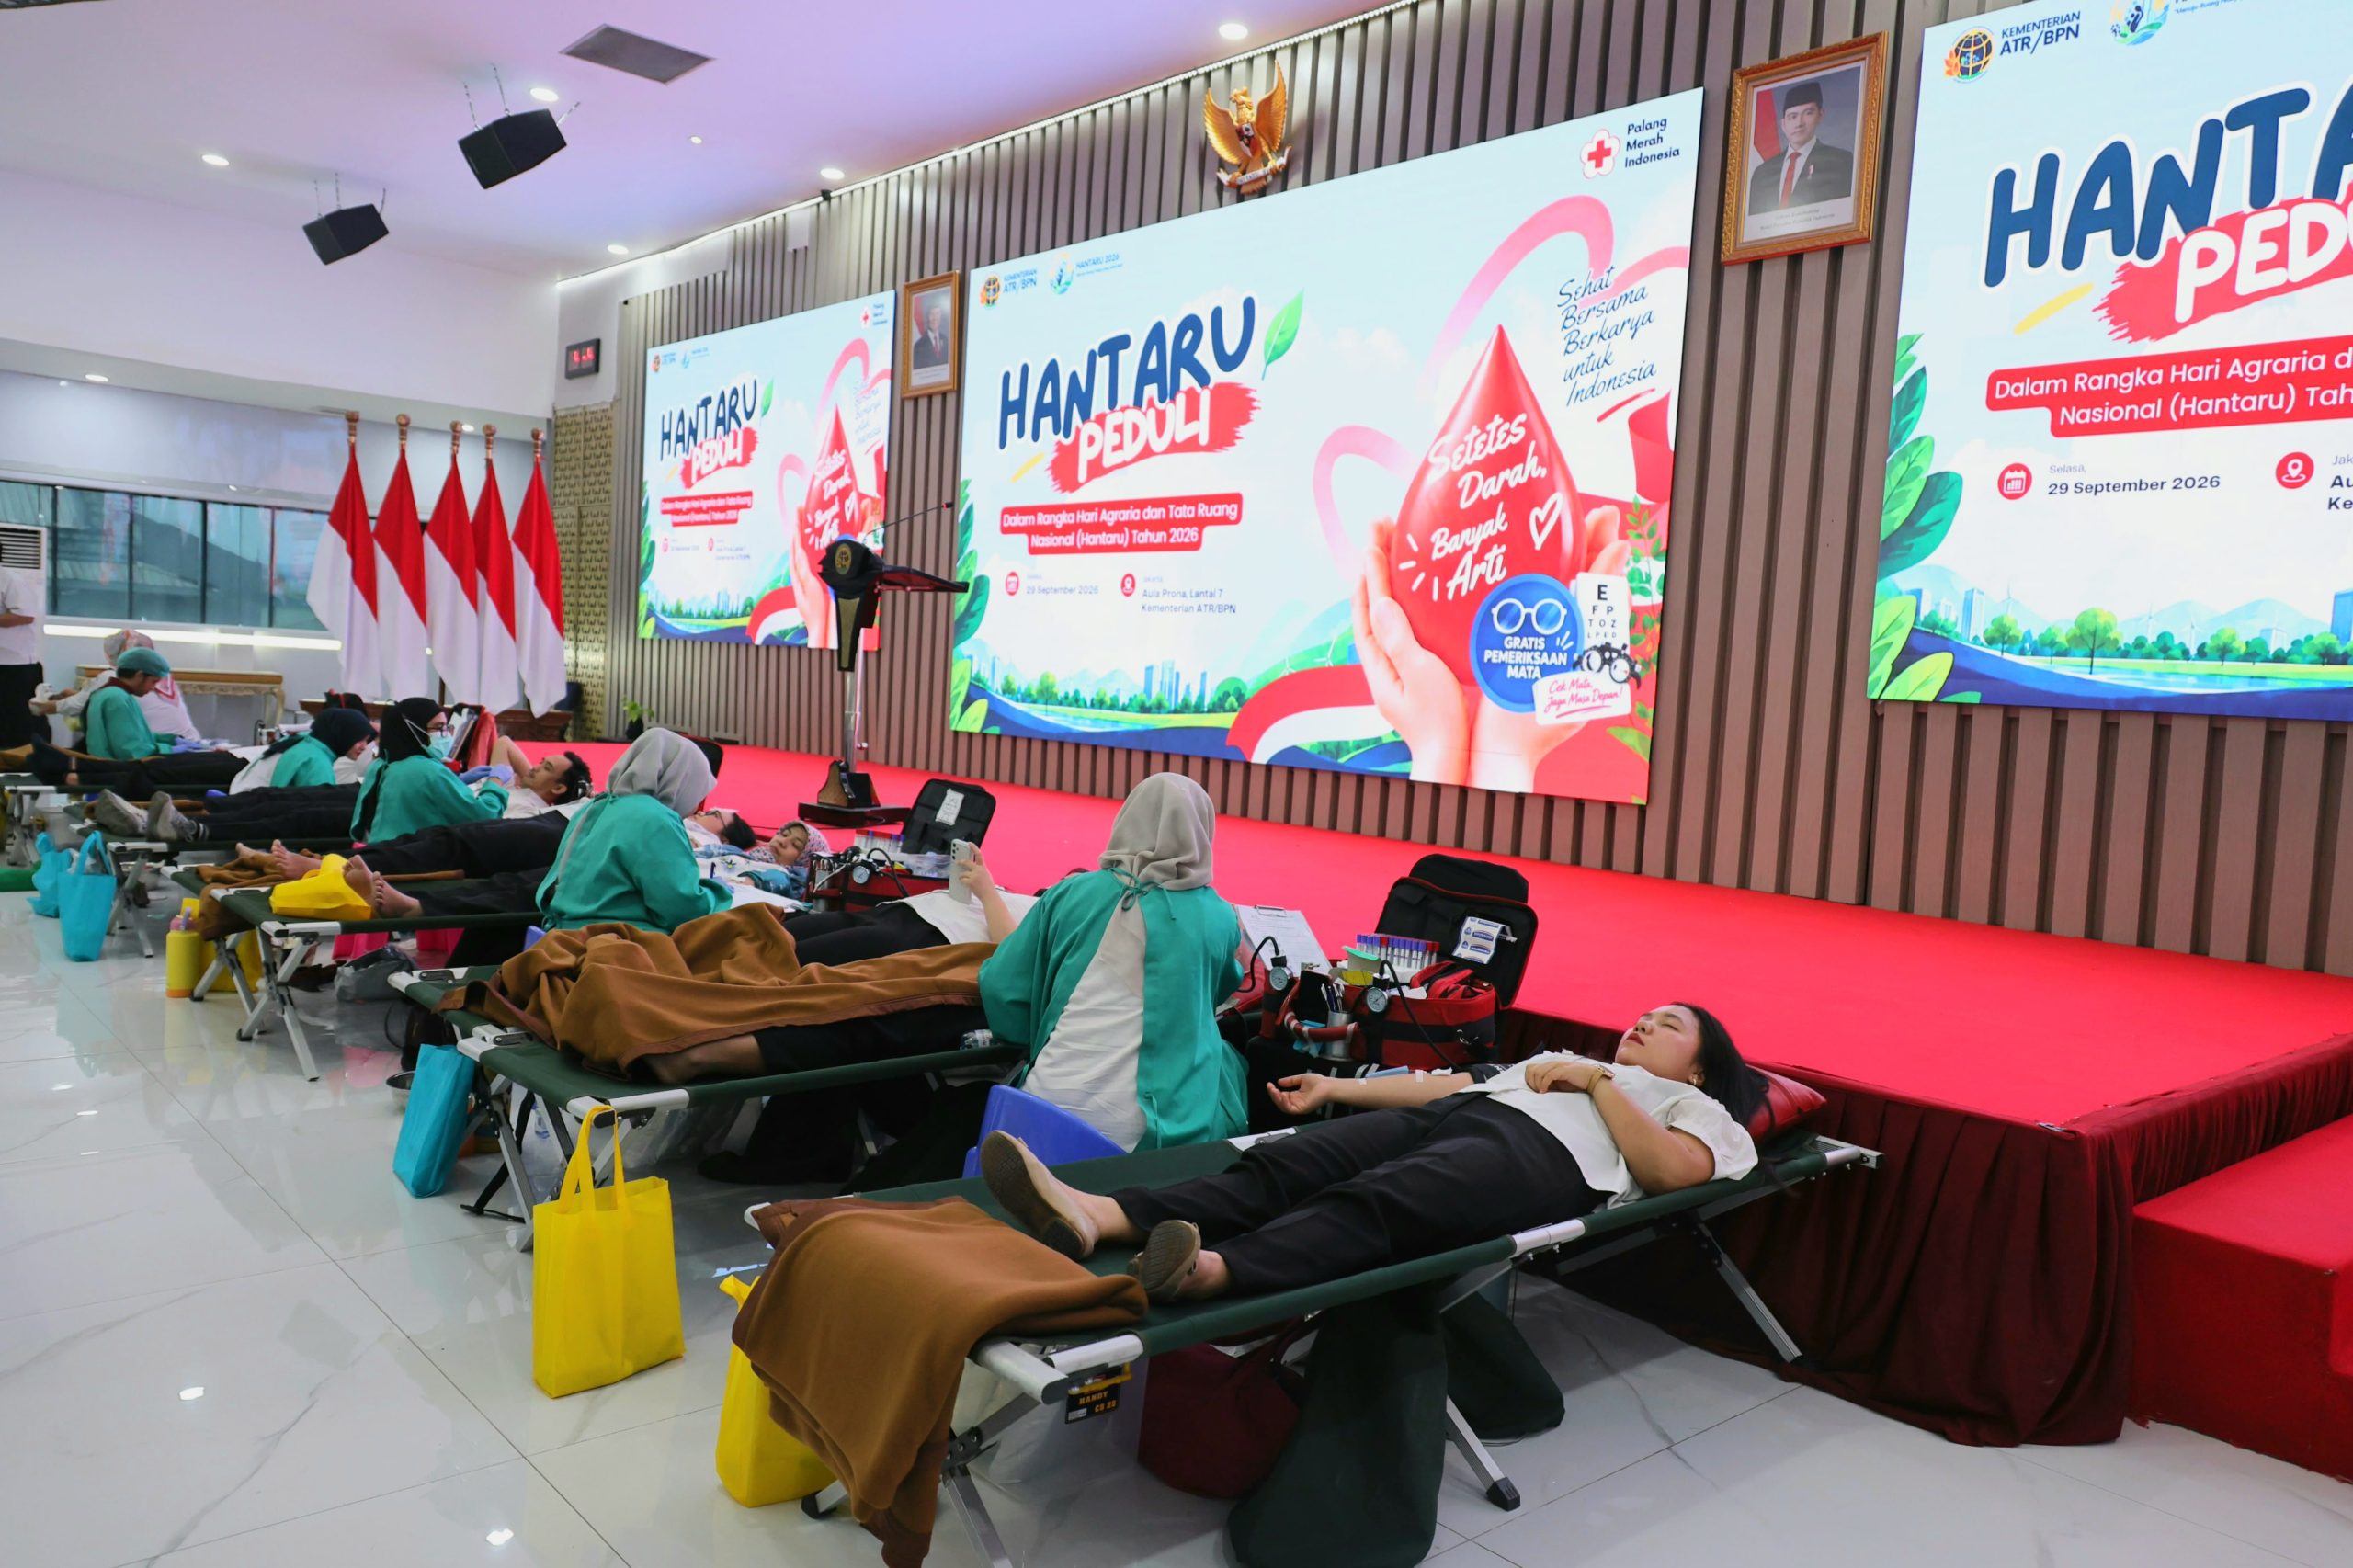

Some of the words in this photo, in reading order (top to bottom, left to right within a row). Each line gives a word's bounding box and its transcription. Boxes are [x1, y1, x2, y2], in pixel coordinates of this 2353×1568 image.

[2001, 11, 2082, 39] KEMENTERIAN
[1999, 24, 2080, 56] ATR/BPN
[1627, 118, 1667, 135] Palang
[1626, 131, 1664, 152] Merah
[1625, 147, 1680, 168] Indonesia
[2175, 200, 2353, 324] PED
[1003, 277, 1038, 294] ATR/BPN
[1557, 265, 1616, 308] Sehat
[1561, 283, 1649, 331] Bersama
[1563, 310, 1655, 357] Berkarya
[998, 296, 1256, 449] HANTARU
[1563, 342, 1615, 382] untuk
[1566, 359, 1656, 407] Indonesia
[1995, 375, 2068, 401] Dalam
[2074, 367, 2163, 398] Rangka
[2169, 358, 2221, 384] Hari
[2226, 349, 2326, 382] Agraria
[2059, 398, 2162, 426] Nasional
[2168, 383, 2296, 423] (Hantaru)
[660, 378, 757, 462] HANTARU
[1077, 388, 1211, 483] PEDULI
[1427, 413, 1528, 485] Setetes
[1457, 439, 1548, 510] Darah,
[2049, 462, 2088, 476] Selasa,
[2047, 483, 2069, 495] 29
[2073, 478, 2167, 498] September
[2172, 475, 2222, 491] 2026
[1002, 513, 1035, 528] Dalam
[1036, 511, 1075, 528] Rangka
[1076, 508, 1098, 523] Hari
[1100, 506, 1141, 526] Agraria
[1142, 506, 1165, 520] dan
[1168, 504, 1195, 518] Tata
[1197, 503, 1238, 520] Ruang
[1030, 533, 1074, 548] Nasional
[1076, 528, 1130, 549] (Hantaru)
[1131, 528, 1167, 544] Tahun
[1169, 527, 1199, 543] 2026
[1430, 501, 1508, 562] Banyak
[1446, 543, 1508, 601] Arti
[1037, 585, 1076, 596] September
[1078, 585, 1099, 595] 2026
[1142, 589, 1160, 598] Aula
[1162, 589, 1188, 599] Prona,
[1189, 588, 1216, 598] Lantai
[1218, 588, 1223, 597] 7
[1597, 584, 1608, 601] E
[1142, 604, 1194, 613] Kementerian
[1197, 604, 1236, 614] ATR/BPN
[1592, 605, 1598, 615] F
[1607, 606, 1614, 616] P
[1588, 619, 1593, 627] T
[1504, 636, 1545, 651] GRATIS
[1483, 650, 1567, 666] PEMERIKSAAN
[1506, 665, 1542, 680] MATA
[1549, 680, 1566, 695] Cek
